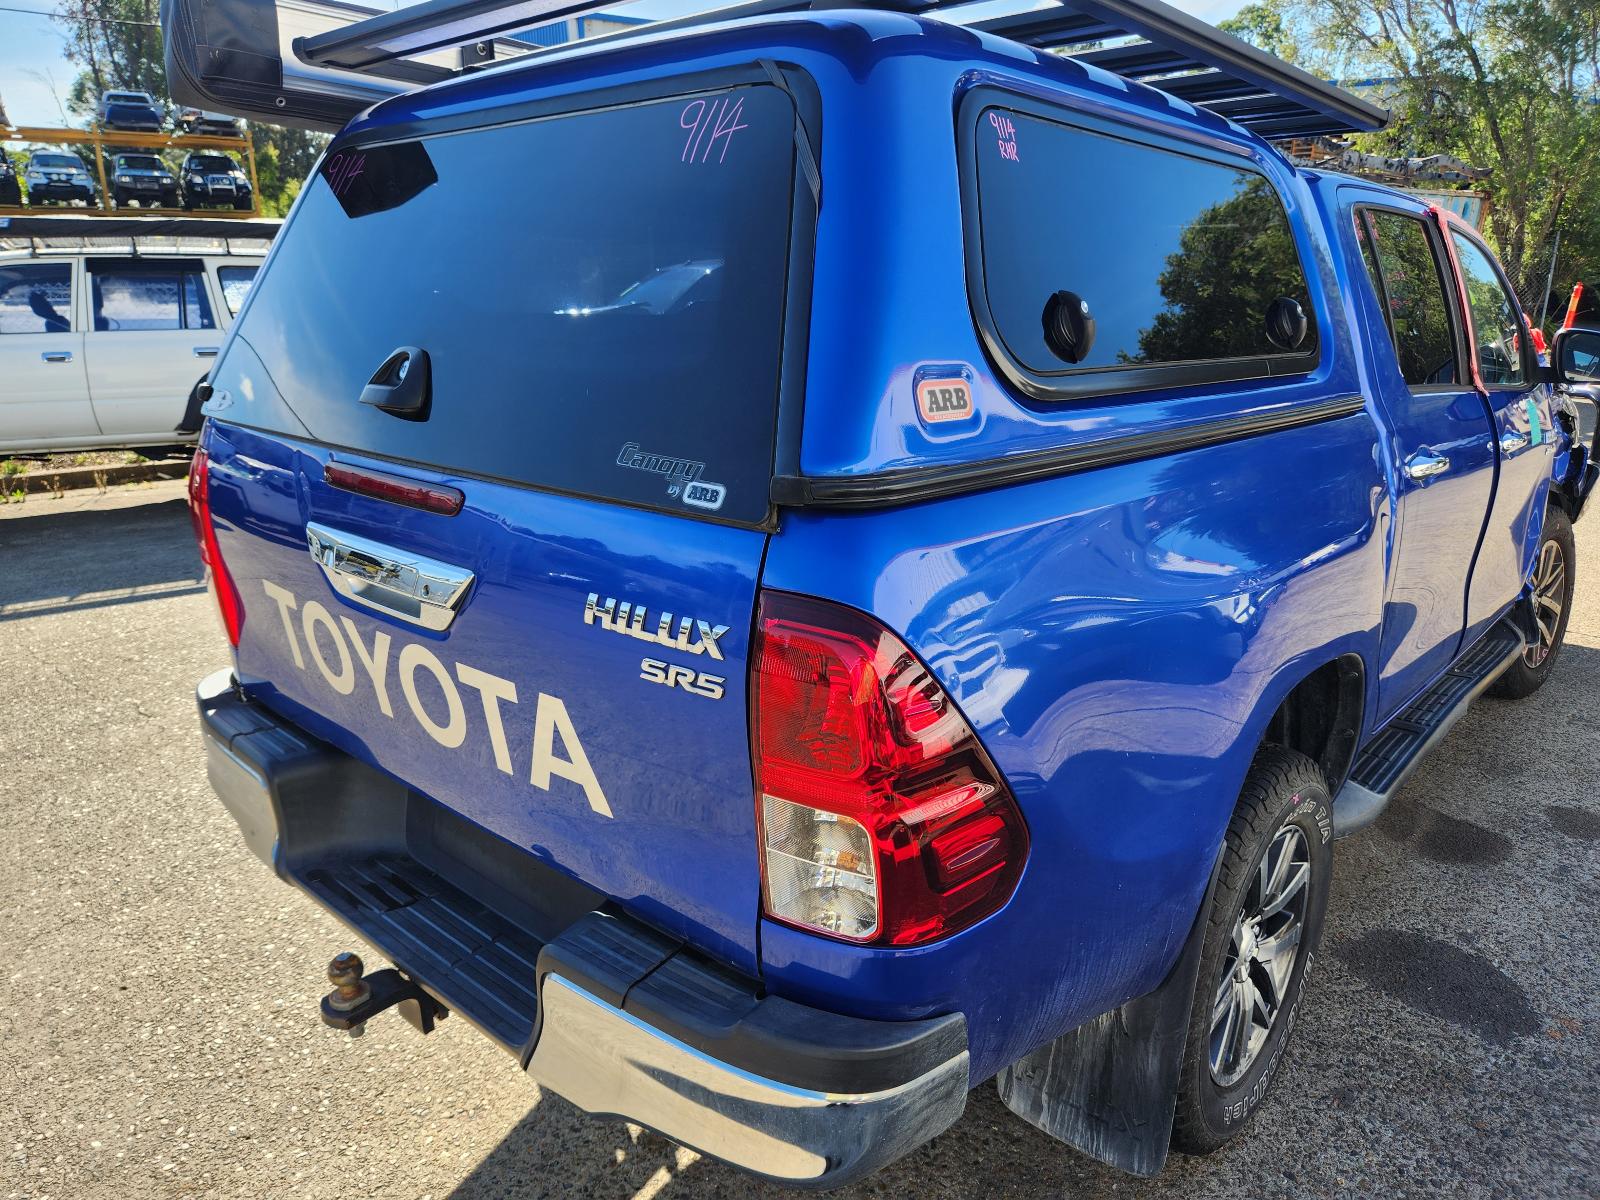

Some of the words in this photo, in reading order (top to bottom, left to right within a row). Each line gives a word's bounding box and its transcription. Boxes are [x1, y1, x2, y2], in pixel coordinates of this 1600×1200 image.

[680, 97, 748, 164] 9114
[989, 112, 1016, 142] 9114
[329, 153, 367, 195] 9114
[927, 387, 969, 413] ARB
[616, 441, 705, 483] Canopy
[667, 484, 683, 498] by
[686, 484, 721, 504] ARB
[583, 591, 731, 661] HILUX
[261, 578, 615, 820] TOYOTA
[639, 657, 727, 700] SR5
